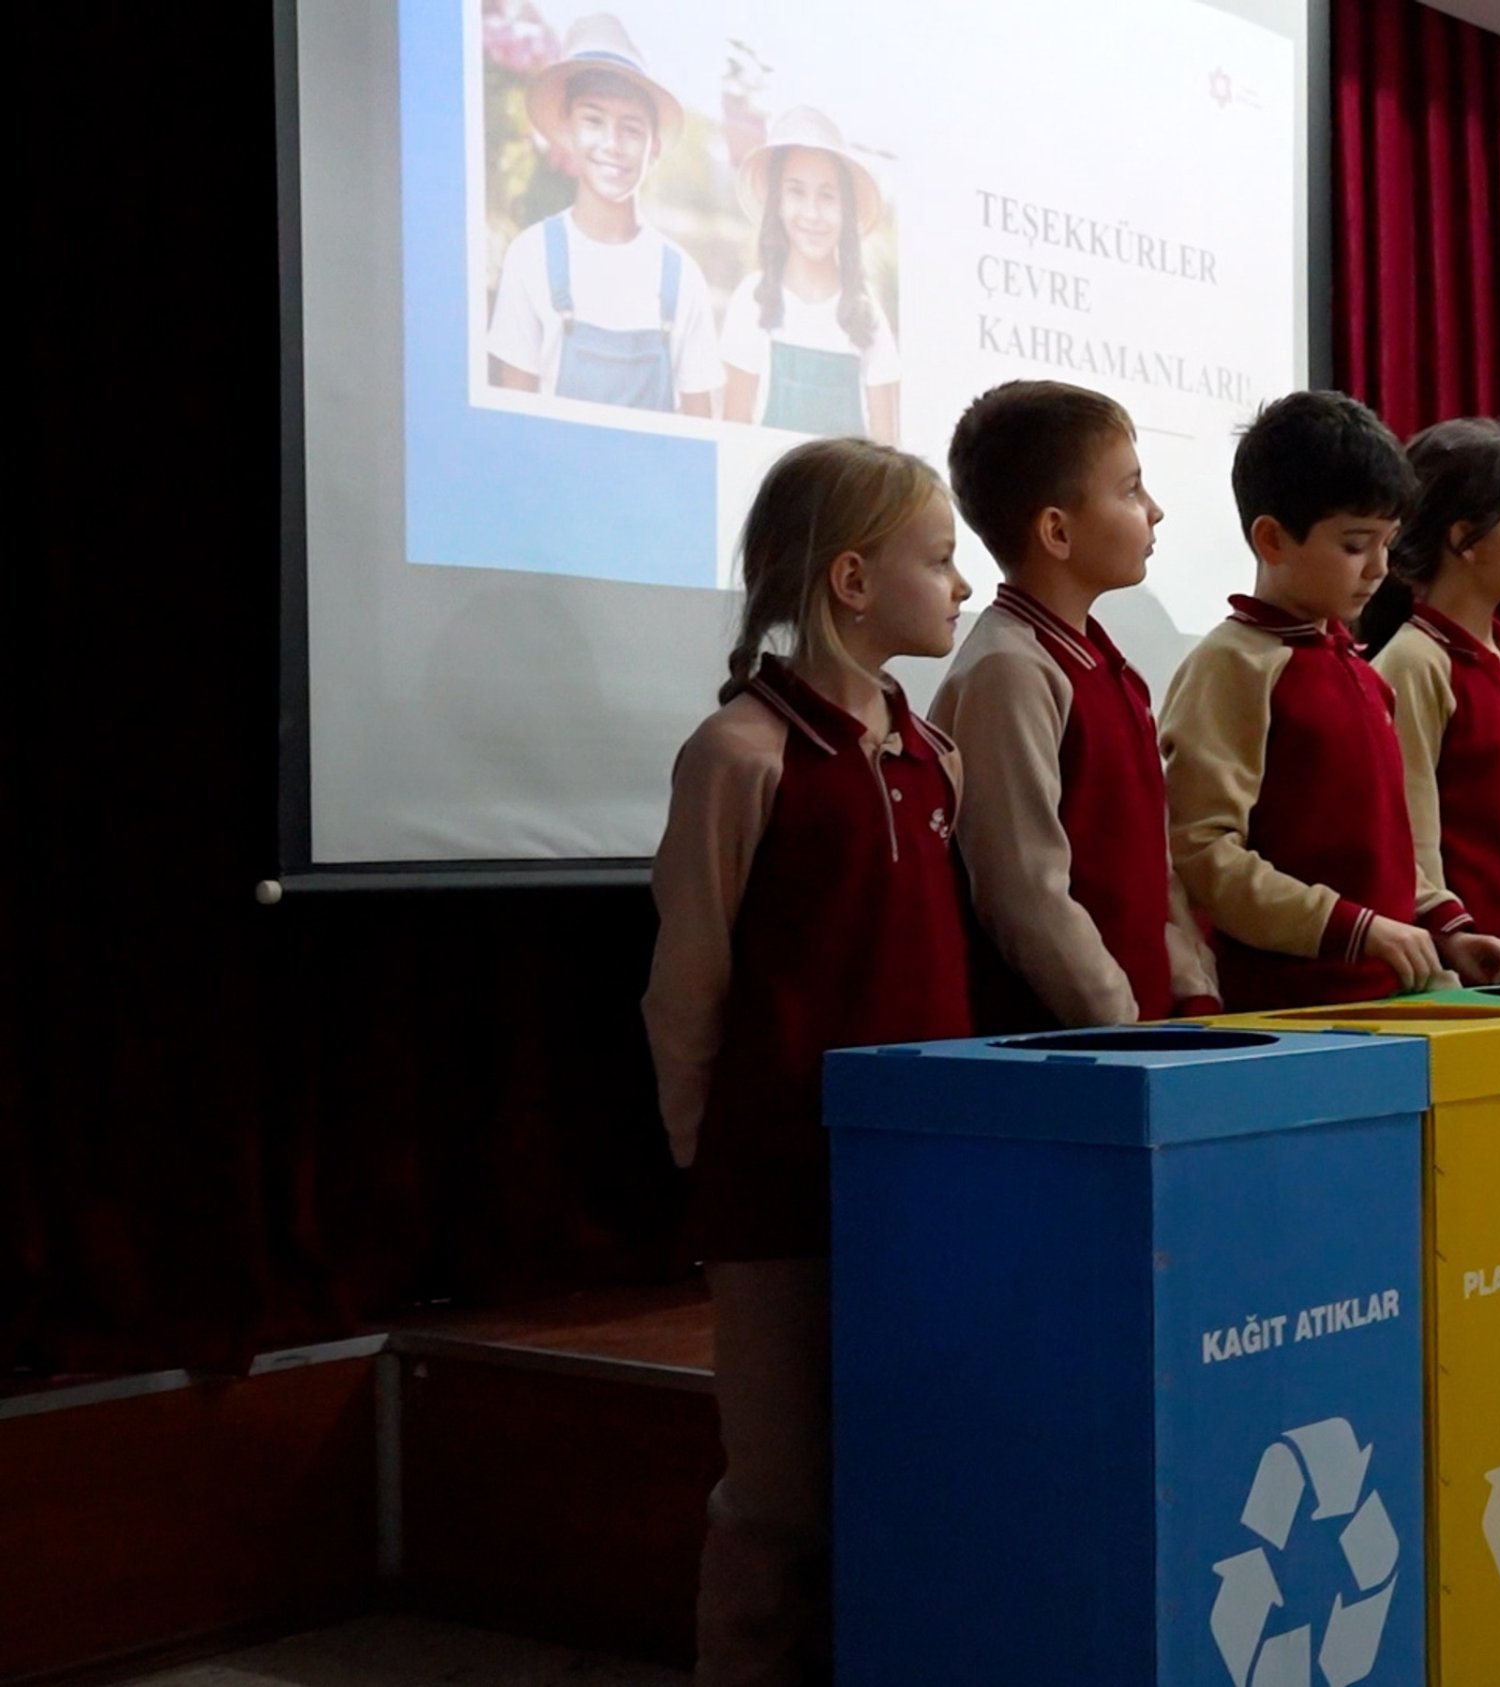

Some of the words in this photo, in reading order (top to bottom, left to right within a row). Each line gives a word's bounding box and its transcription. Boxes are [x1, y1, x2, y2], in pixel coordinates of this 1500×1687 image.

[977, 190, 1218, 285] TEŞEKKÜRLER
[977, 254, 1093, 313] ÇEVRE
[1203, 1314, 1287, 1363] KAĞIT
[1294, 1289, 1399, 1342] ATIKLAR
